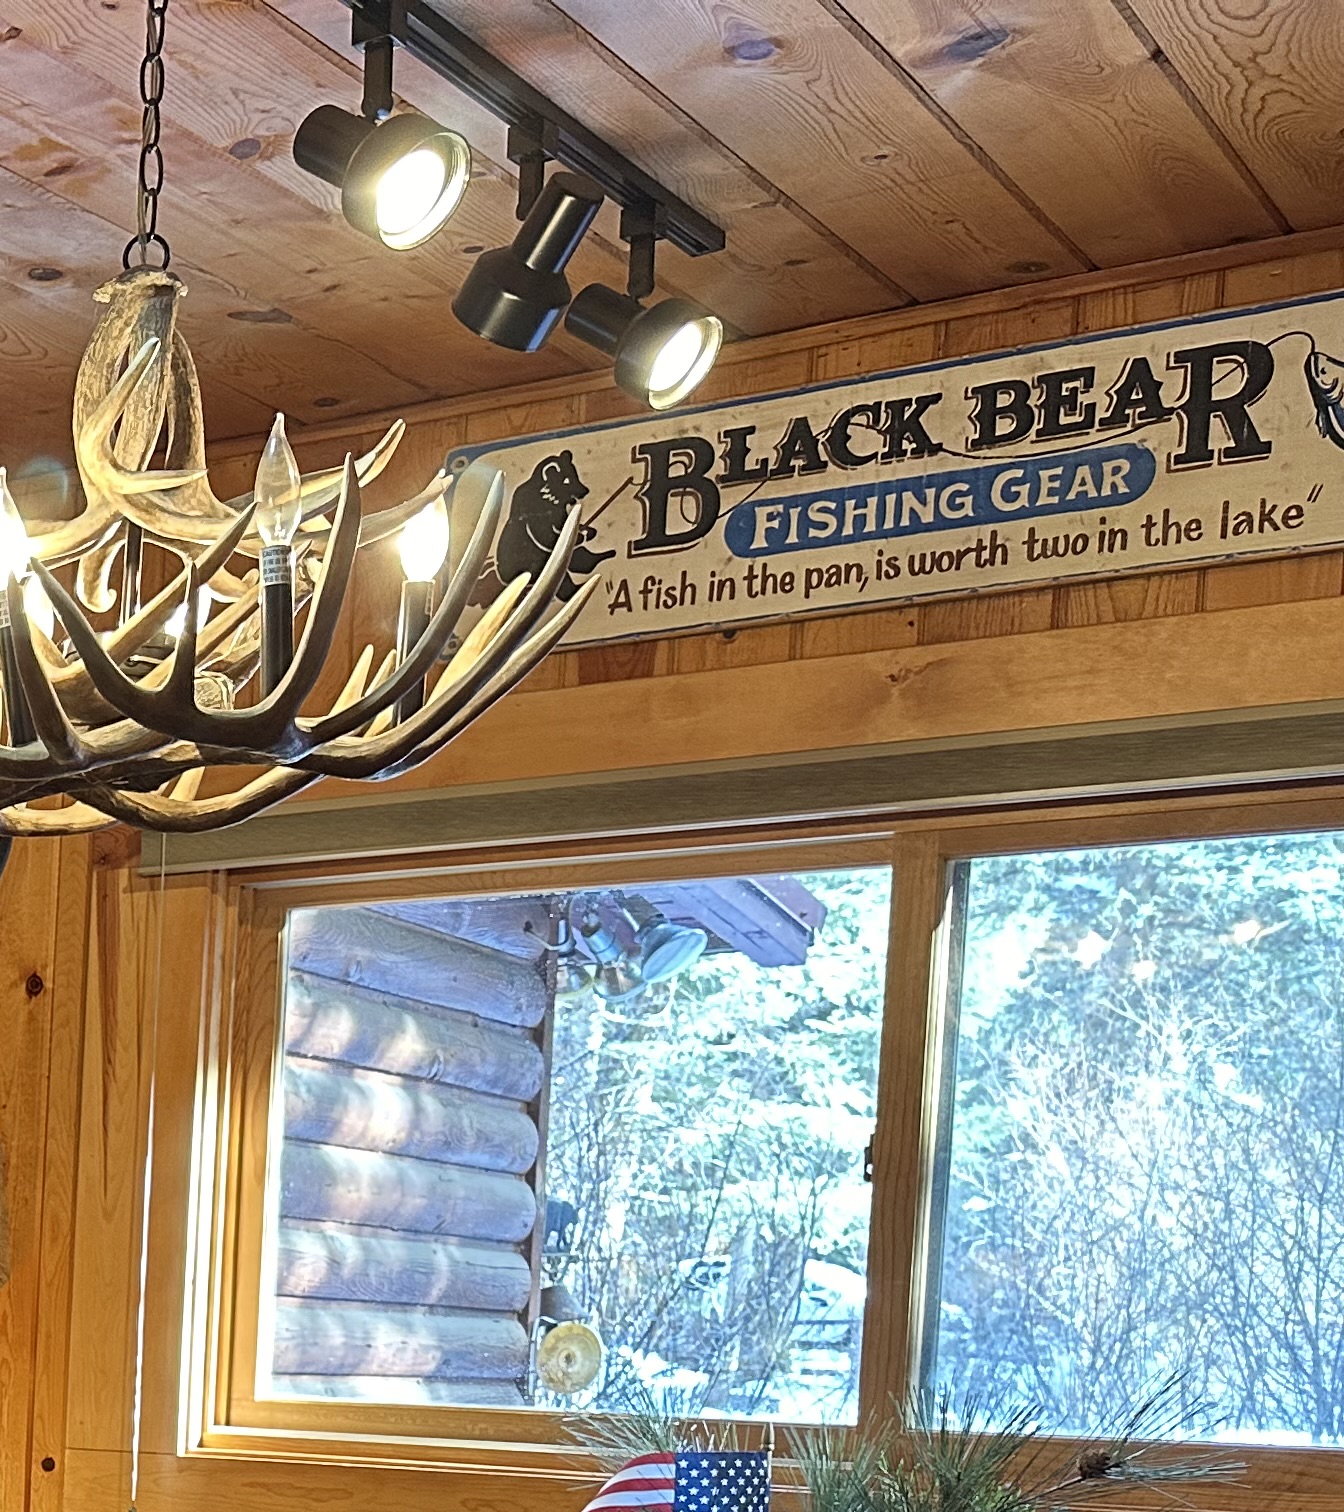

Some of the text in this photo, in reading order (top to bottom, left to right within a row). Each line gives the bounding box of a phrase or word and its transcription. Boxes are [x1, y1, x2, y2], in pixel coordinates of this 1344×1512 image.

[627, 340, 1275, 559] BLACK BEAR
[749, 458, 1132, 550] FISHING GEAR
[642, 571, 697, 612] fish
[708, 571, 736, 603] in
[742, 562, 795, 600] the
[804, 566, 869, 600] pan,
[876, 550, 901, 581] is
[908, 530, 1009, 576] worth
[1022, 526, 1089, 561] two
[1097, 516, 1128, 554] in
[1141, 509, 1203, 547] the
[1220, 483, 1324, 540] lake"
